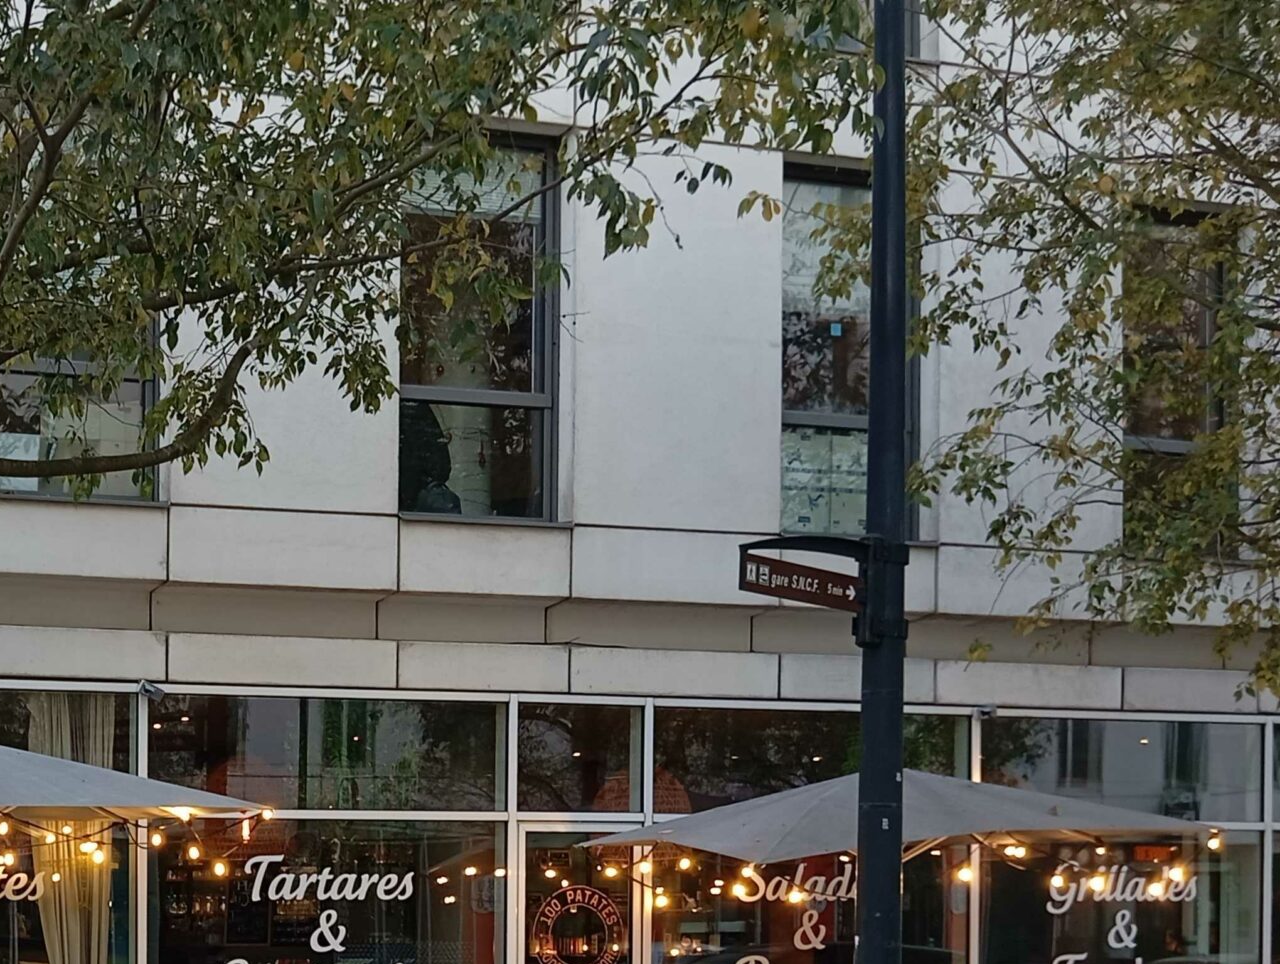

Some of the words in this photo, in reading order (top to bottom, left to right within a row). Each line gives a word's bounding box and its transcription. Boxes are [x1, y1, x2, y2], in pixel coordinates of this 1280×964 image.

[771, 573, 789, 588] gare
[827, 582, 832, 594] 5
[832, 586, 843, 597] min
[244, 854, 415, 902] Tartares
[736, 862, 857, 902] Salad
[1046, 860, 1198, 914] Grillades
[540, 898, 561, 925] 100
[566, 889, 617, 925] PATATES
[309, 909, 347, 953] &
[793, 909, 826, 950] &
[1107, 909, 1138, 949] &
